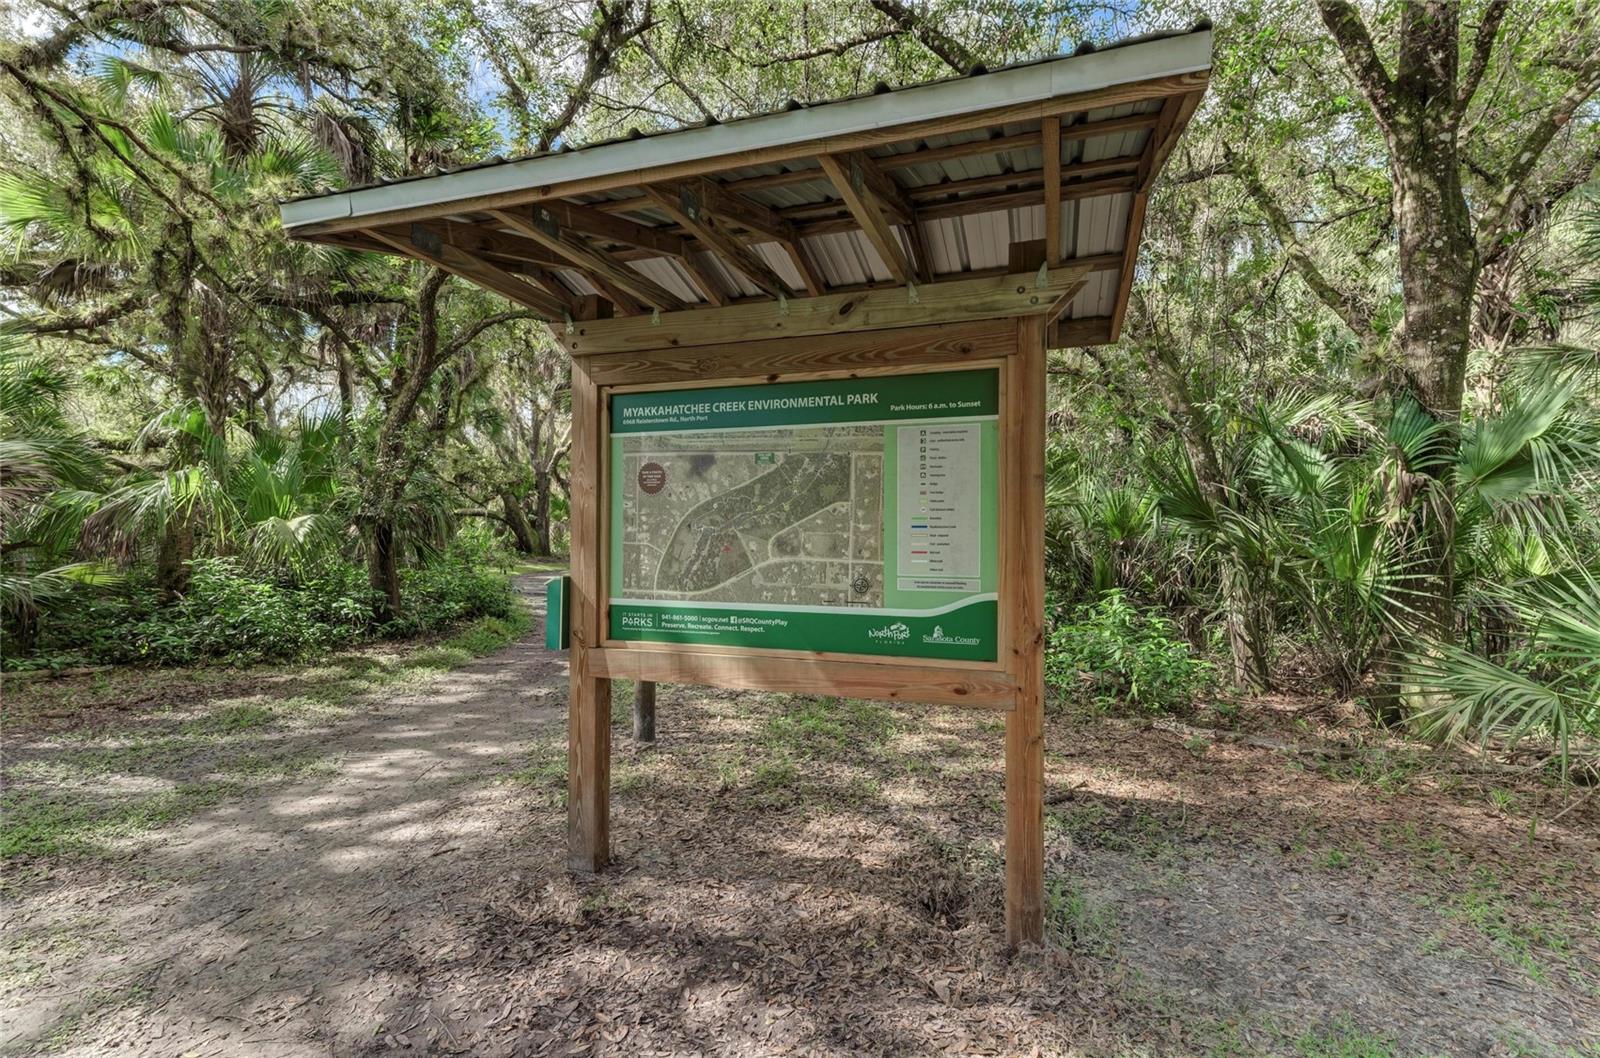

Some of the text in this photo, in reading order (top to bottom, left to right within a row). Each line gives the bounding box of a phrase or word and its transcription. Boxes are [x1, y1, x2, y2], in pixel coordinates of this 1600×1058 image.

[623, 392, 879, 417] MYAKKAHATCHEE CREEK ENVIRONMENTAL PARK
[957, 400, 981, 408] Sunset
[622, 616, 653, 627] PARKS
[740, 625, 765, 633] Respect.
[954, 636, 981, 644] County
